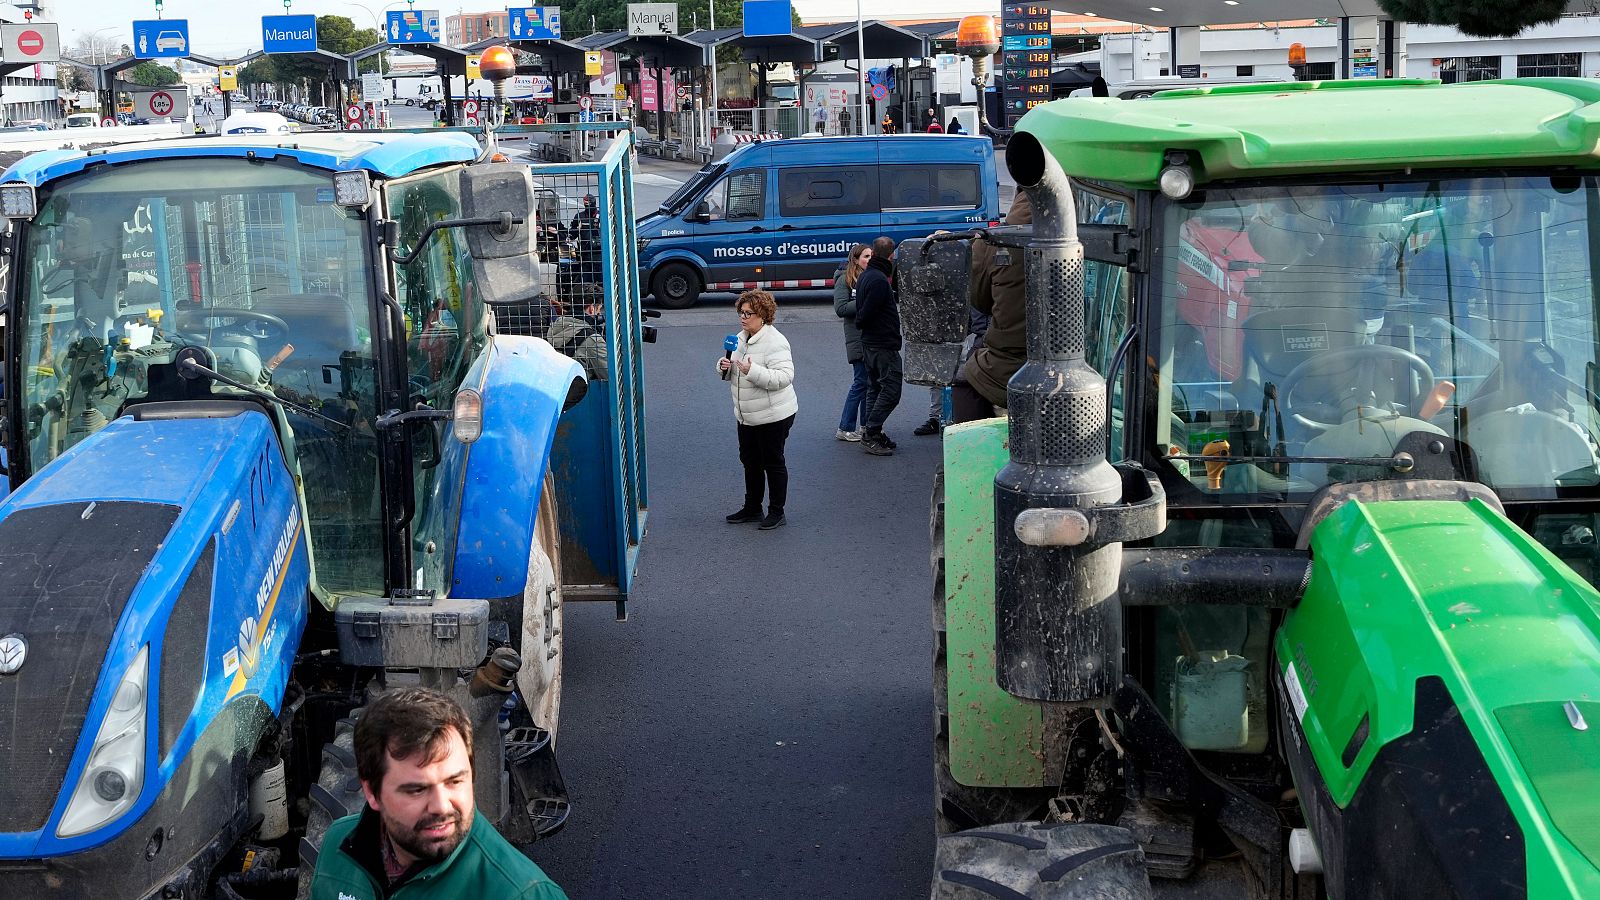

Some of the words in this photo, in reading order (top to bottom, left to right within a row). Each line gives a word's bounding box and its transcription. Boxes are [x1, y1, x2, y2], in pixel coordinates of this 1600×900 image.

[631, 11, 674, 23] Manual
[265, 27, 313, 41] Manual
[713, 245, 772, 258] mossos
[1286, 335, 1324, 344] DEUTZ
[1290, 342, 1321, 350] FAHR
[256, 561, 275, 615] NEW
[272, 504, 298, 577] HOLLAND
